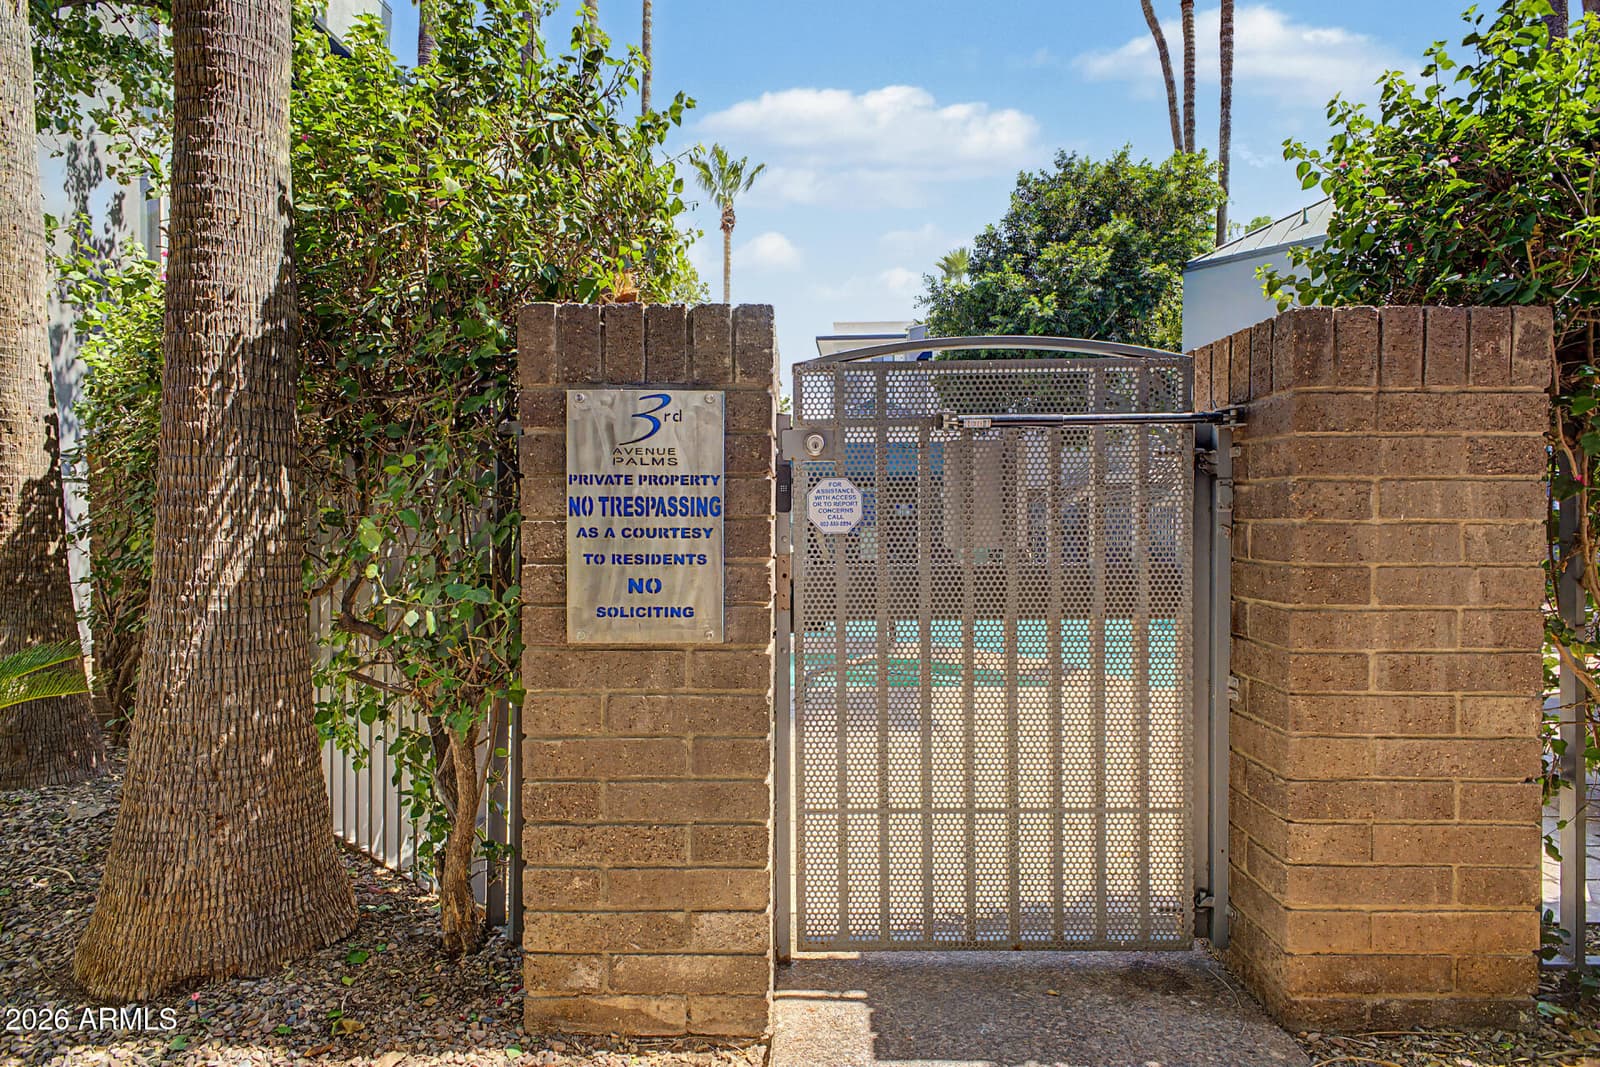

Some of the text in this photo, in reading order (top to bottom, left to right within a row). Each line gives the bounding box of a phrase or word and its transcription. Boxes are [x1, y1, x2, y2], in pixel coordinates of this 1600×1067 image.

[619, 393, 682, 446] 3rd
[612, 447, 676, 456] AVENUE
[612, 457, 678, 466] PALMS
[568, 474, 721, 486] PRIVATE PROPERTY
[568, 496, 721, 518] NO TRESPASSING
[576, 527, 714, 539] AS A COURTESY
[583, 553, 707, 565] TO RESIDENTS
[628, 577, 662, 594] NO
[596, 606, 695, 618] SOLICITING
